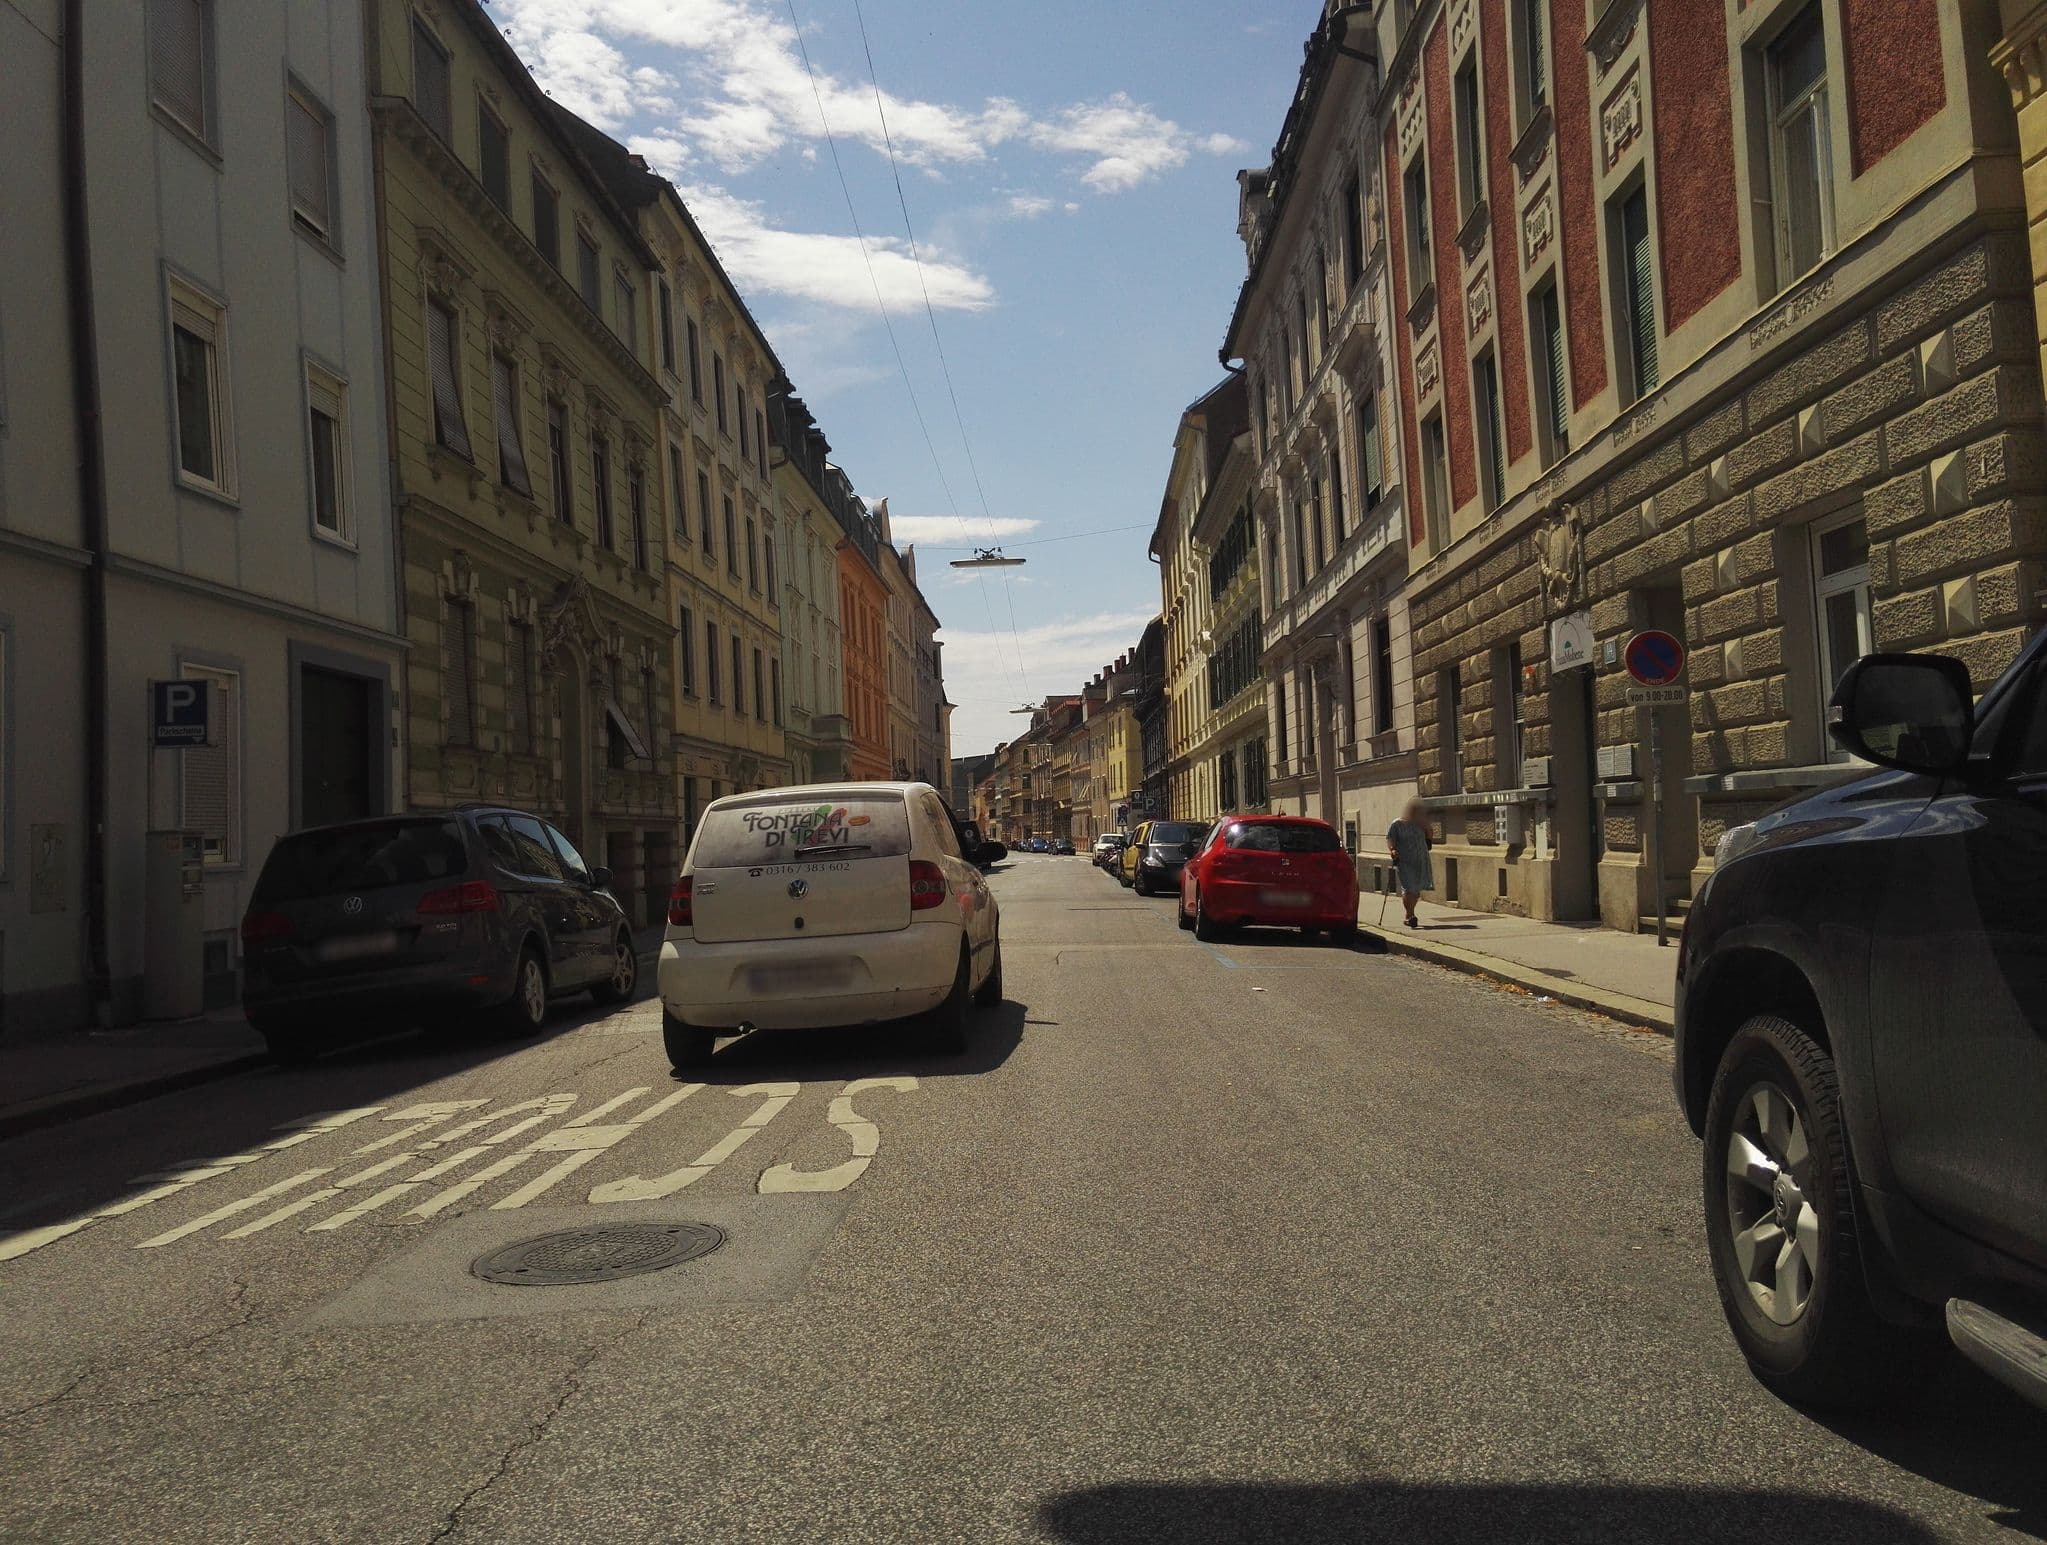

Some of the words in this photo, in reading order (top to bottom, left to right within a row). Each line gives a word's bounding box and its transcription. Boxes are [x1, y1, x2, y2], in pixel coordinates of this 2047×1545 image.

[166, 685, 197, 722] P
[1630, 694, 1644, 702] von
[743, 811, 842, 833] FONTANA
[765, 831, 786, 848] DI
[790, 824, 849, 845] TREVI
[765, 864, 794, 875] 0316
[806, 863, 825, 873] 383
[829, 862, 850, 872] 602
